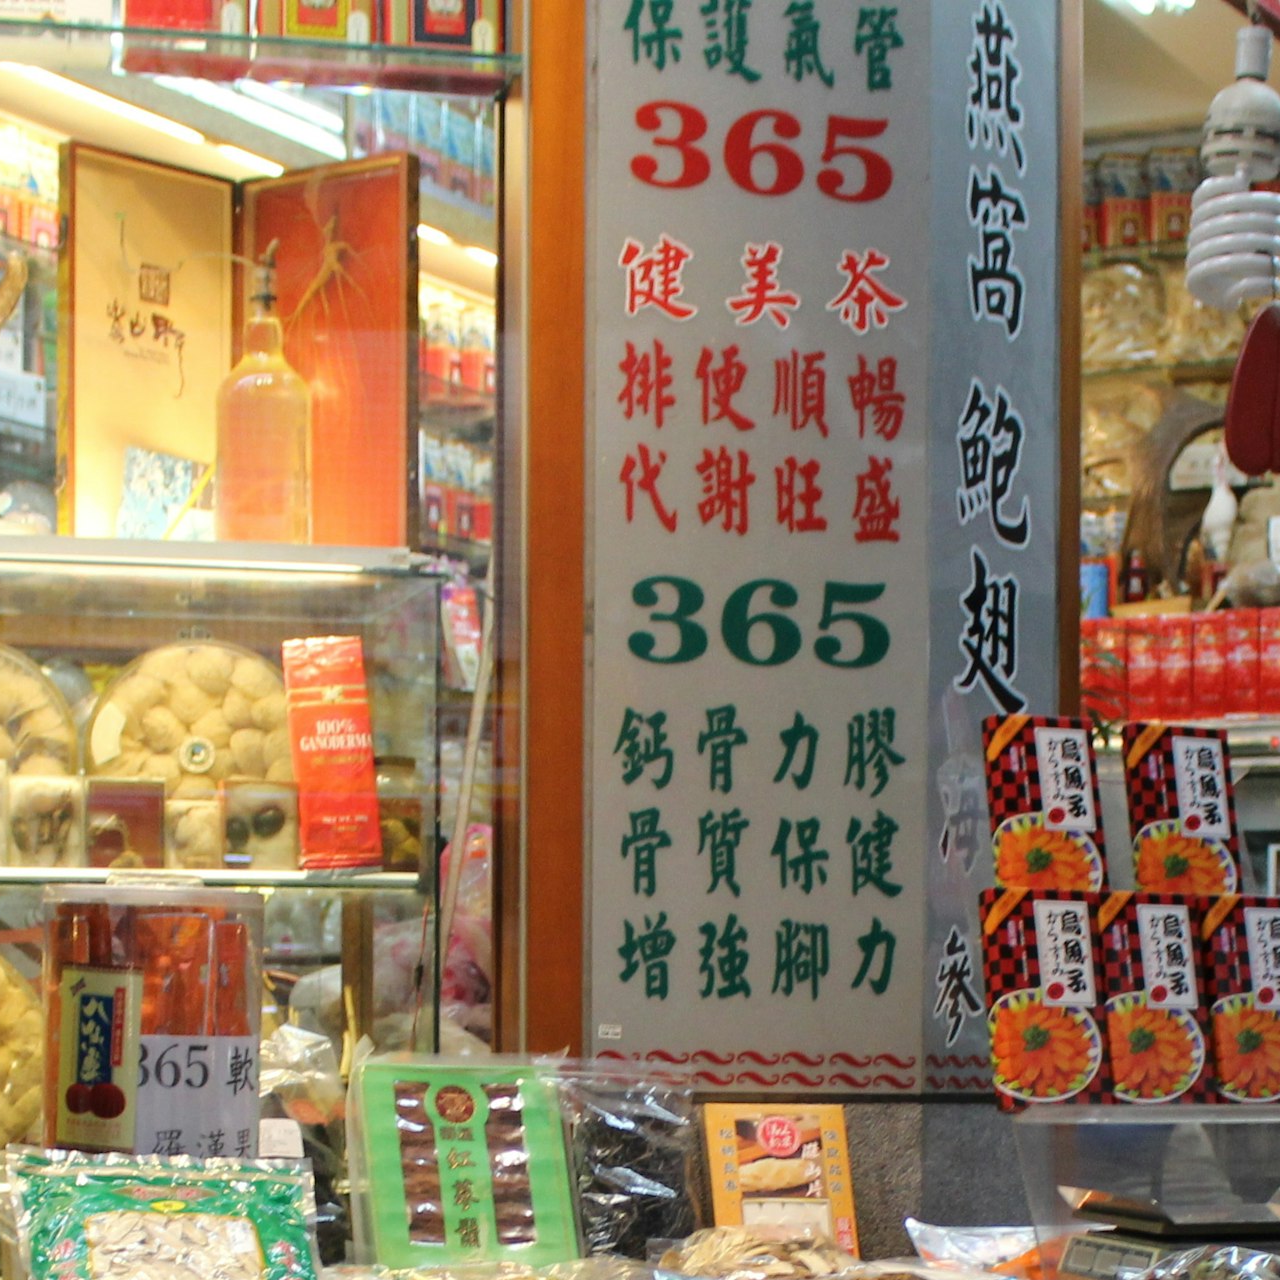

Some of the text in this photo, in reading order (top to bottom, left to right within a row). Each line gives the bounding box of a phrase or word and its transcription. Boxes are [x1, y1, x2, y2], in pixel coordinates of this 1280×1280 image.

[624, 0, 904, 91] 保護氣管
[630, 101, 893, 202] 365
[619, 234, 907, 333] 健美茶
[618, 338, 906, 442] 排便順暢
[619, 443, 901, 543] 代謝旺盛
[627, 576, 891, 667] 365
[613, 702, 907, 797] 鈣骨力膠
[620, 807, 903, 899] 骨質保健
[617, 911, 898, 1001] 增強腳力
